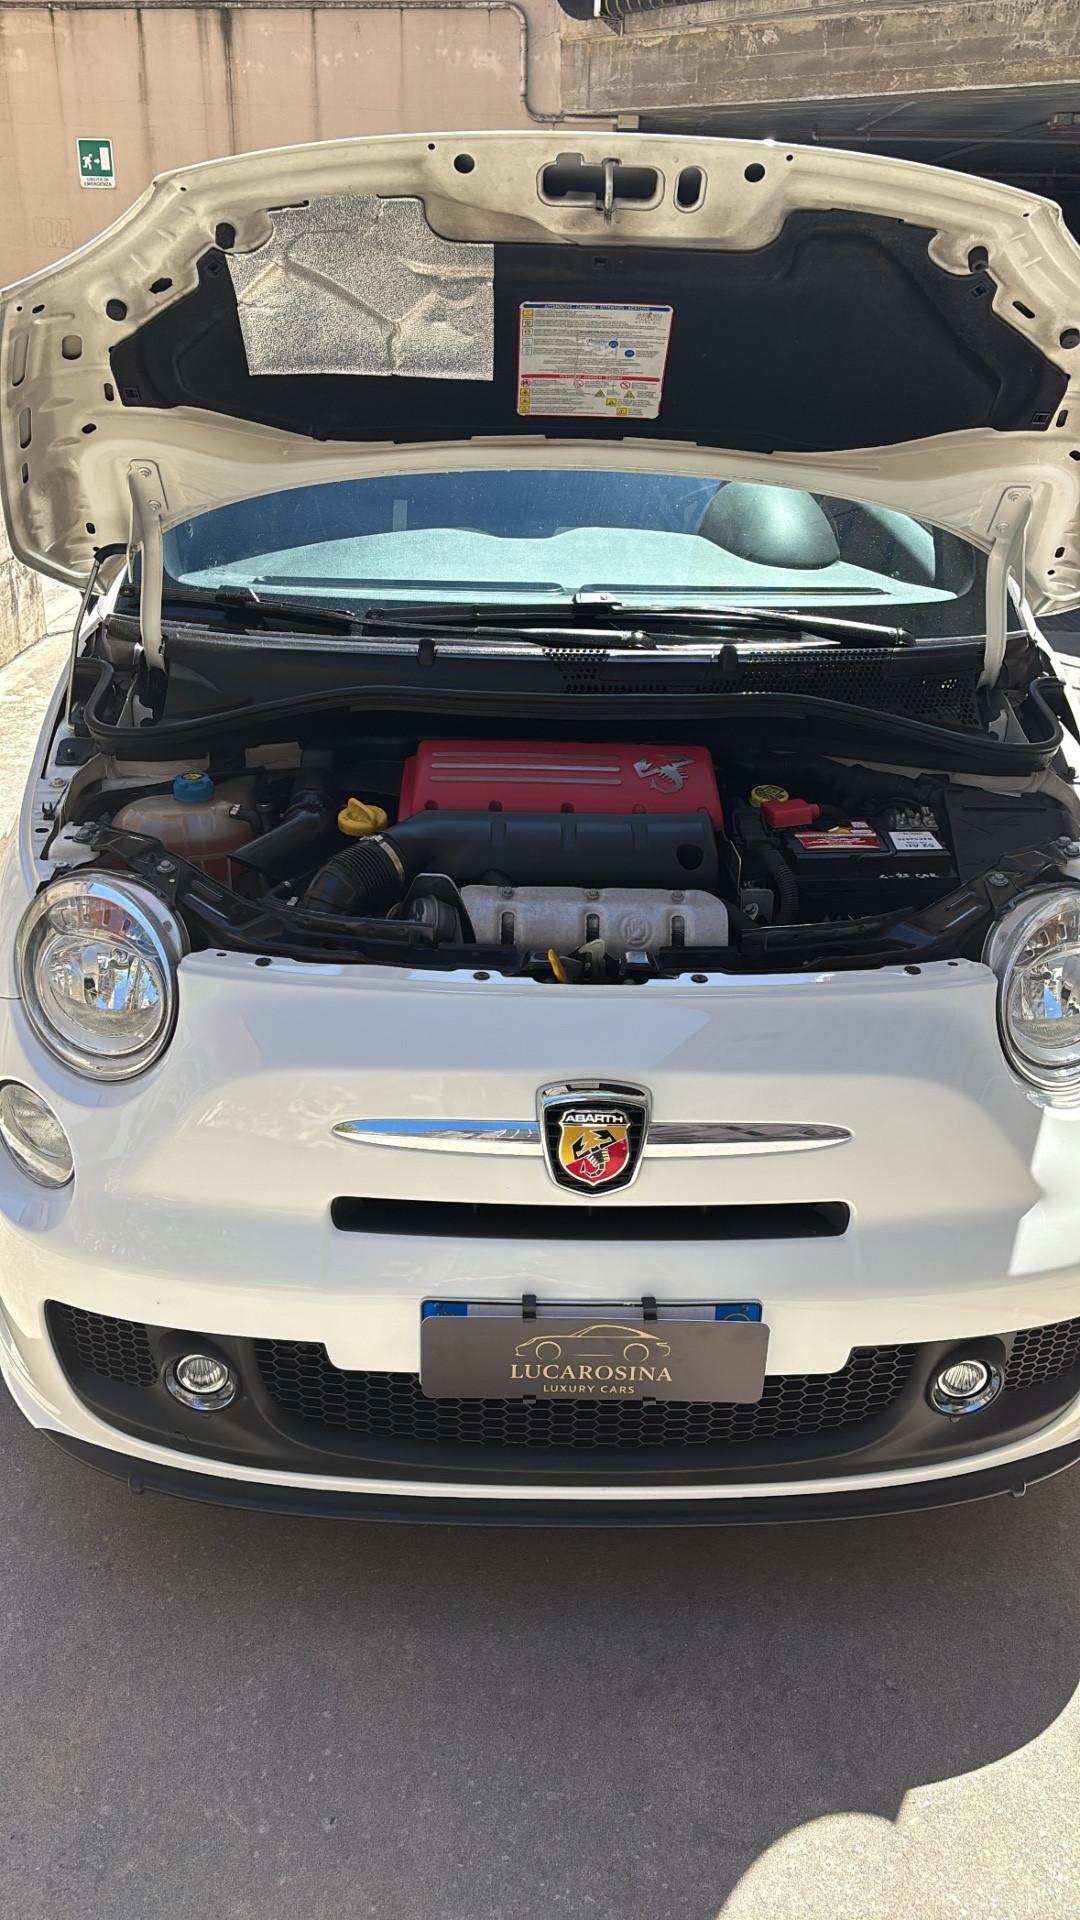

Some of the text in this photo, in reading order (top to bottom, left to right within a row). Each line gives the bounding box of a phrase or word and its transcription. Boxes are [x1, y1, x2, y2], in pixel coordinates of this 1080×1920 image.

[565, 1114, 623, 1122] ABARTH
[510, 1364, 672, 1382] LUCAROSINA
[543, 1384, 635, 1394] LUXURY CARS
